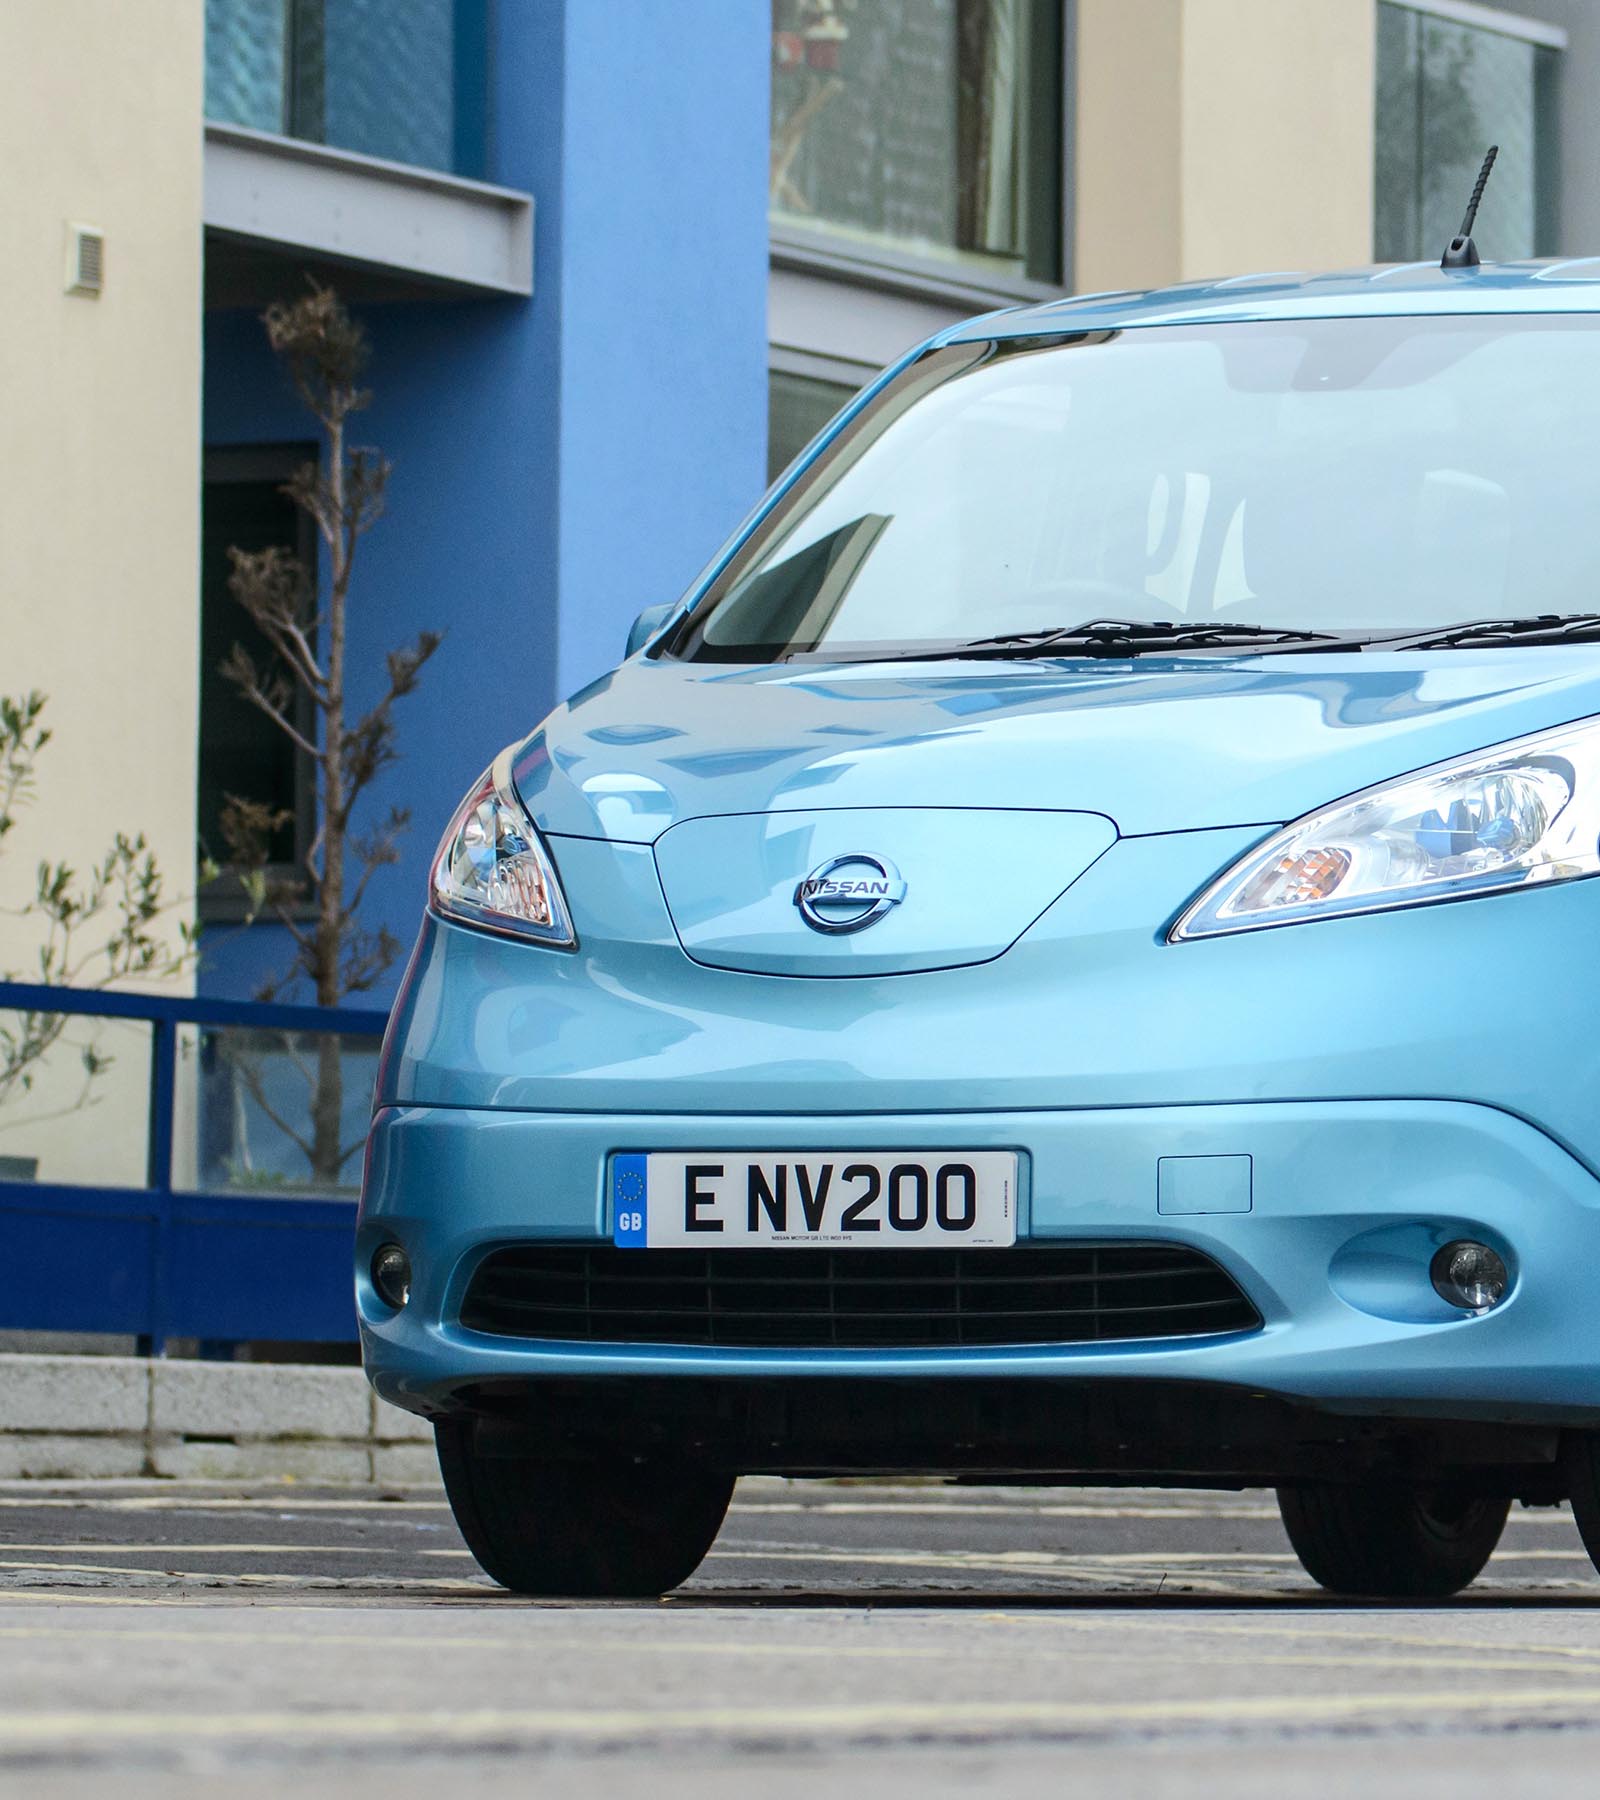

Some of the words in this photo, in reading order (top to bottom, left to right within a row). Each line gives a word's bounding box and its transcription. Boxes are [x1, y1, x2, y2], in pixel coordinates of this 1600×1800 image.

[803, 881, 889, 895] NISSAN
[685, 1165, 724, 1232] E
[748, 1164, 976, 1232] NV200
[619, 1212, 642, 1231] GB
